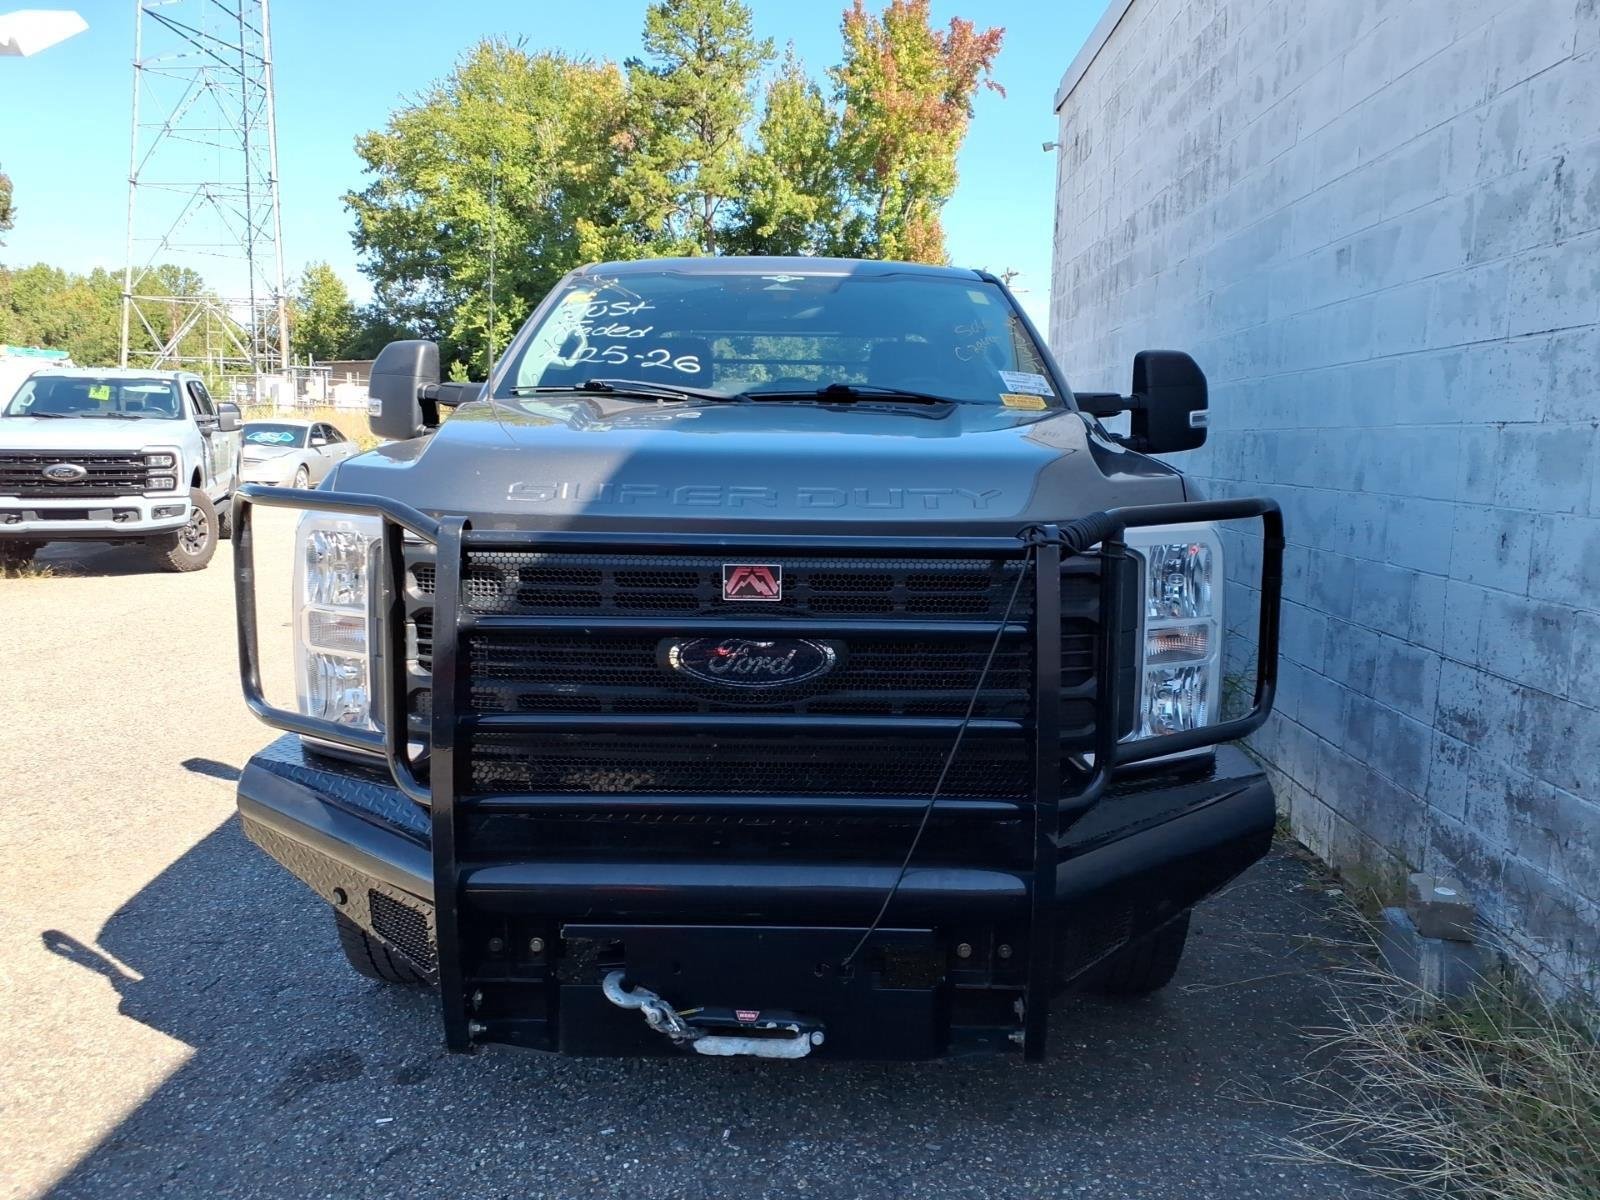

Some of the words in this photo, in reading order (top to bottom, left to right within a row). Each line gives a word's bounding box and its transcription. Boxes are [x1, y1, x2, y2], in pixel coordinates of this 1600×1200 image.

[506, 481, 778, 508] SUPER
[797, 486, 1003, 510] DUTY
[708, 638, 798, 675] Ford
